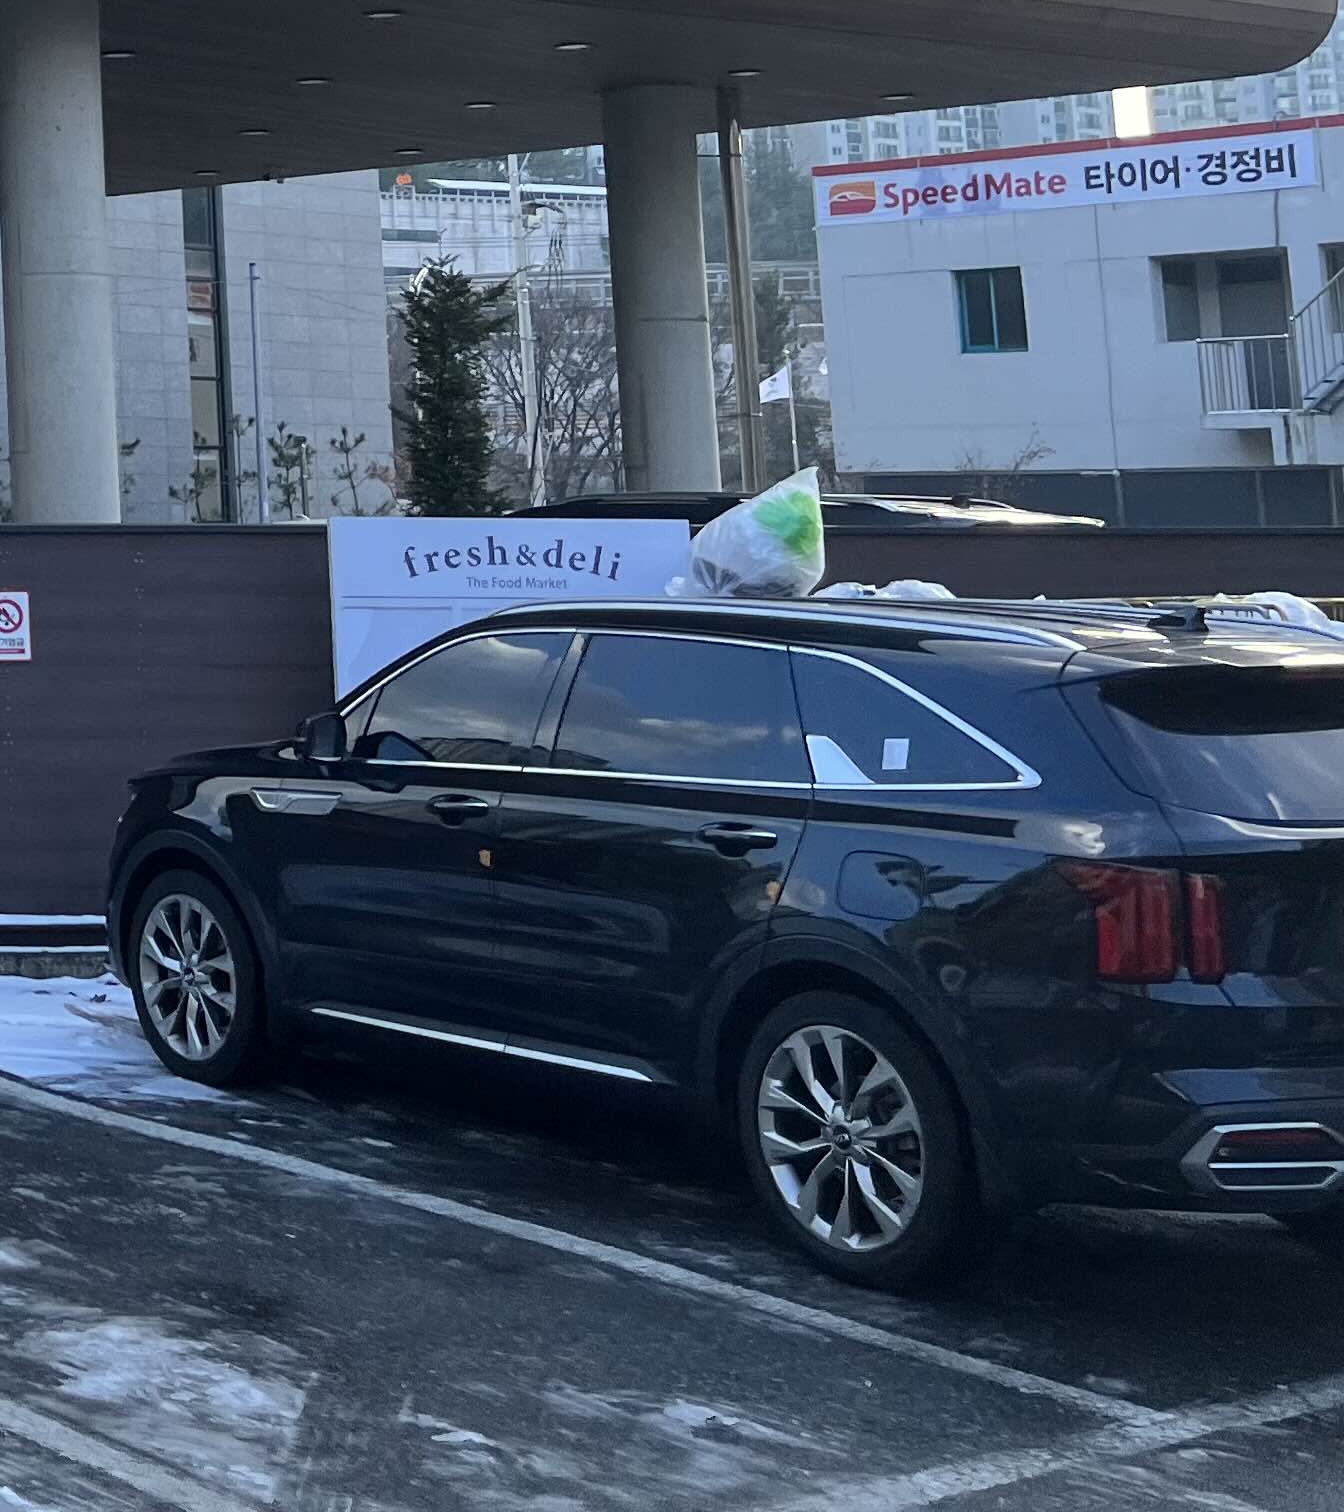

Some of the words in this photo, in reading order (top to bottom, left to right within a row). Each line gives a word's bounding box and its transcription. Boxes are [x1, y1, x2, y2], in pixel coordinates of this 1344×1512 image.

[883, 171, 1068, 216] SpeedMate
[403, 535, 622, 582] fresh&deli
[466, 576, 489, 590] The
[491, 576, 522, 590] Food
[525, 576, 568, 590] Market
